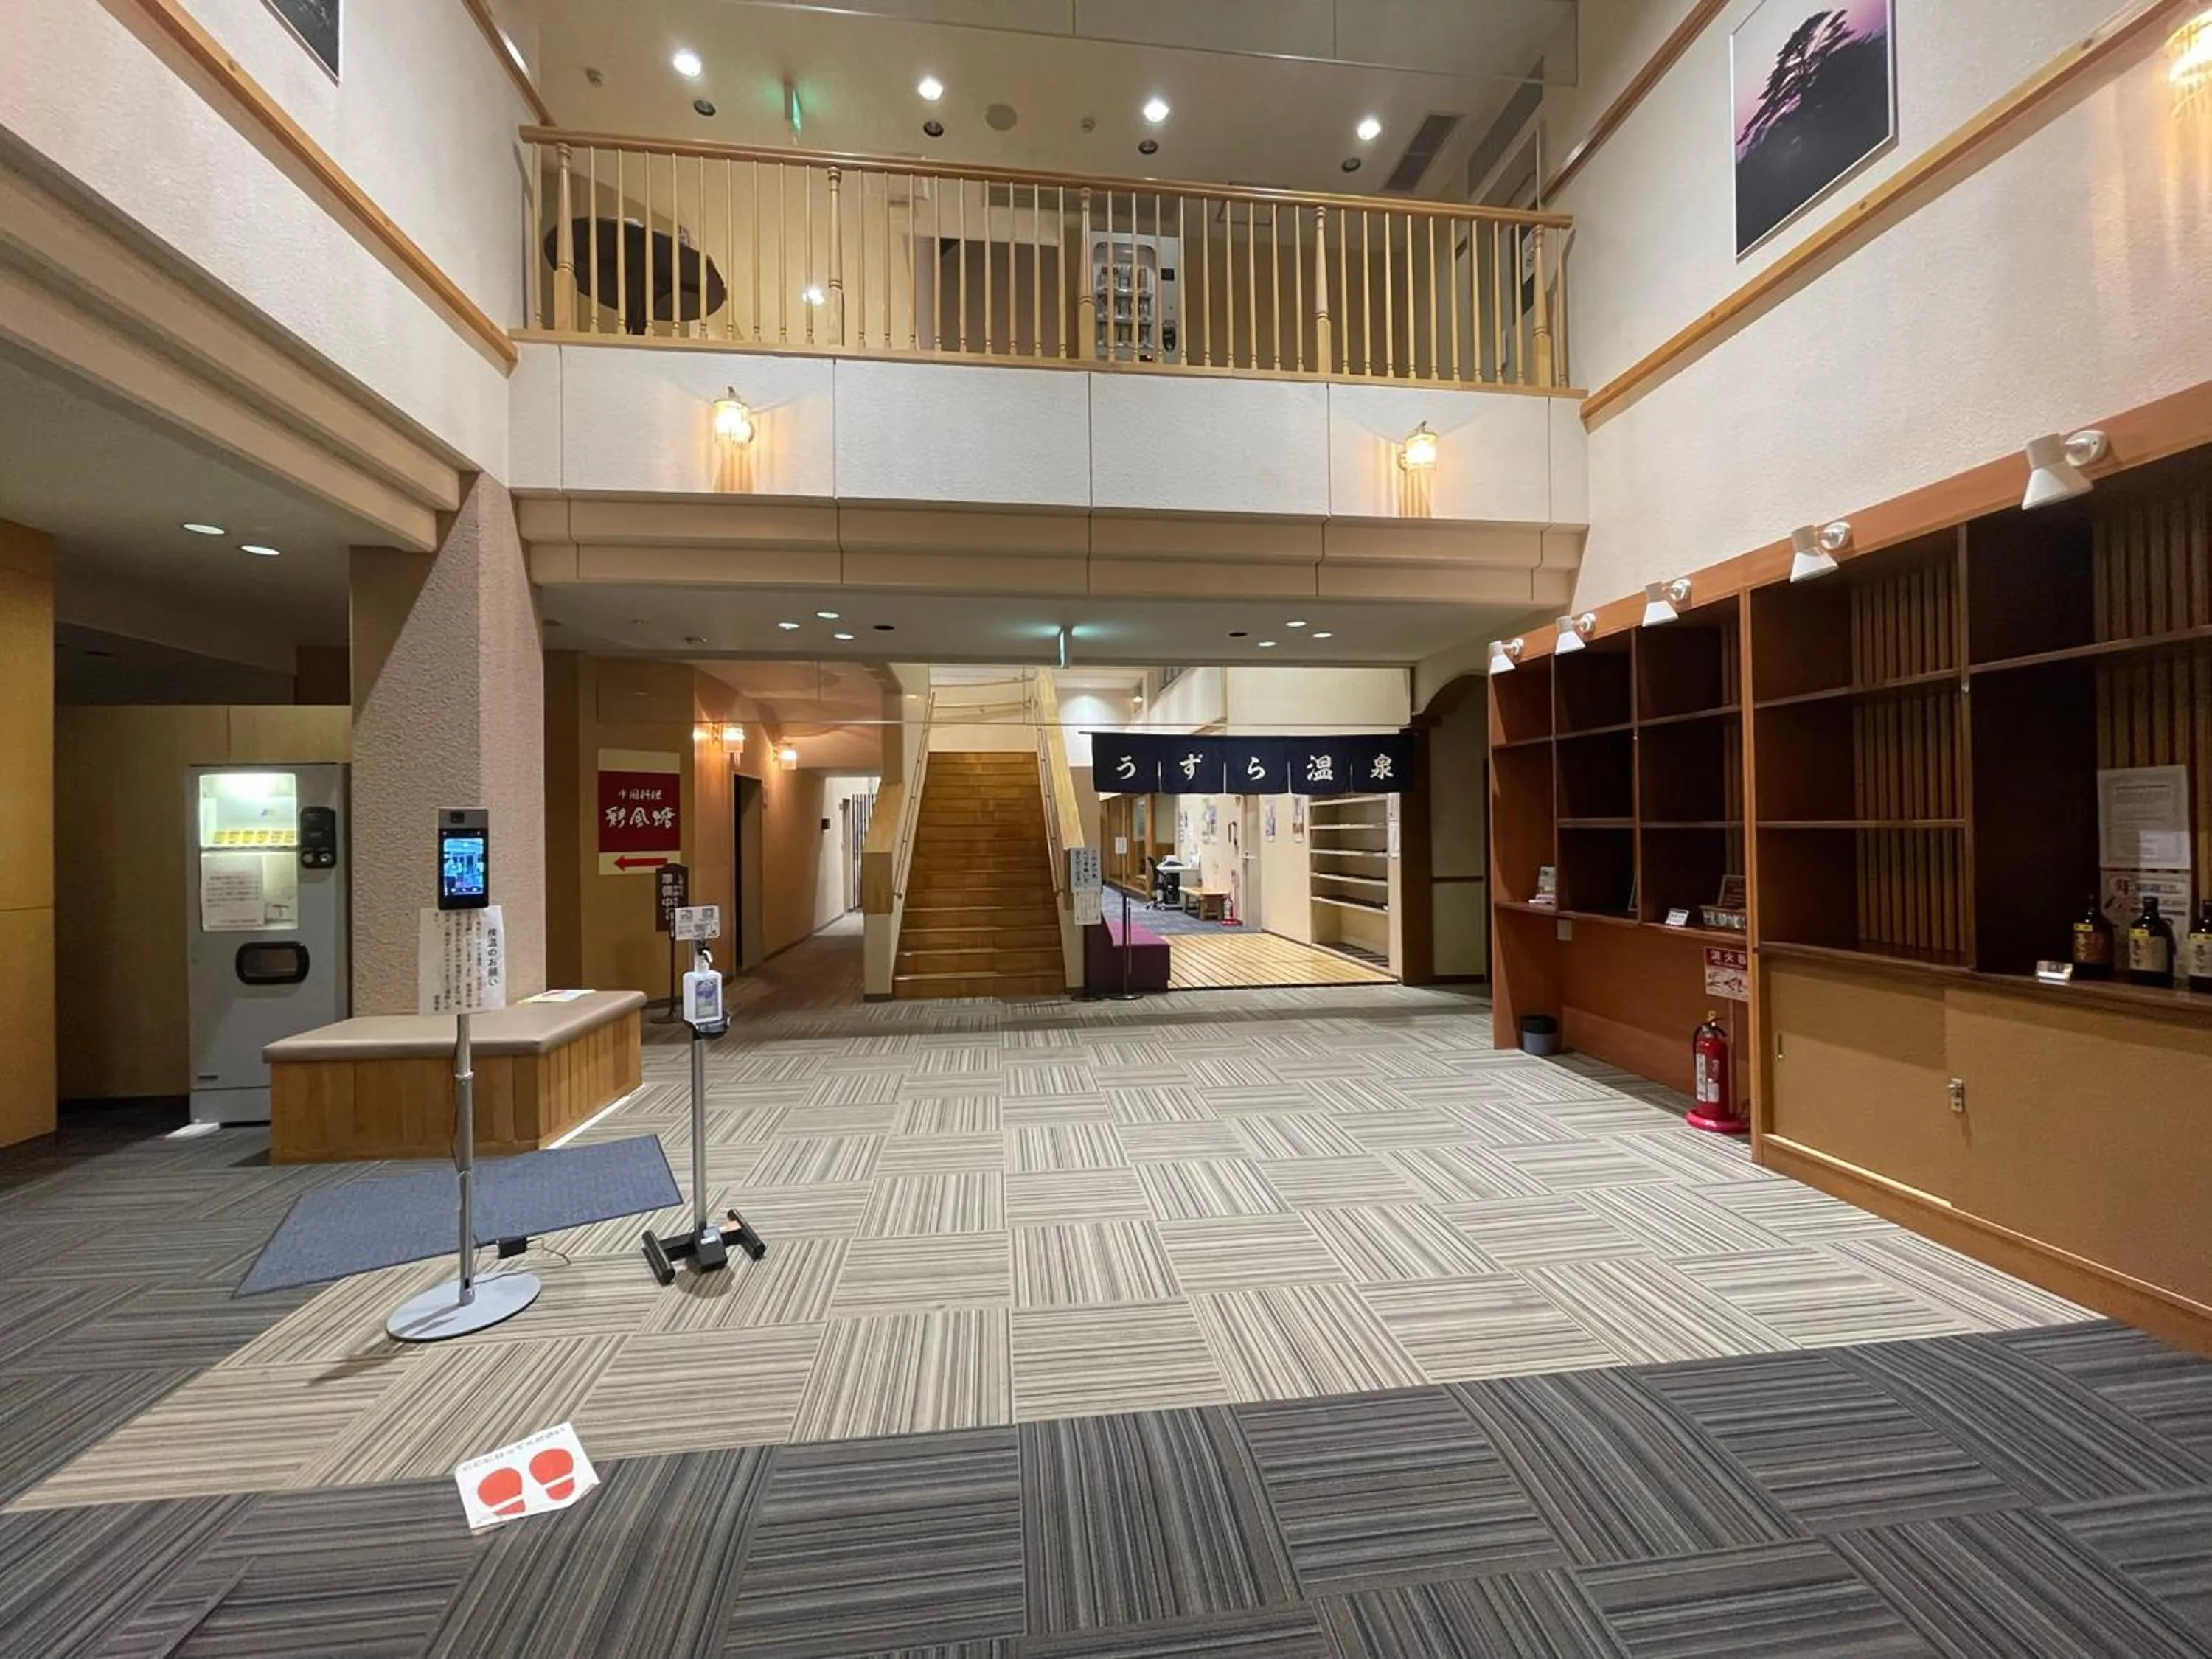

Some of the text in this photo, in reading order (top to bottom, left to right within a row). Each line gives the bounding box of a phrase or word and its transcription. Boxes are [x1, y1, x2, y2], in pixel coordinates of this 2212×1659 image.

[1116, 753, 1394, 782] うずら温泉
[487, 928, 498, 987] 検温のお願い
